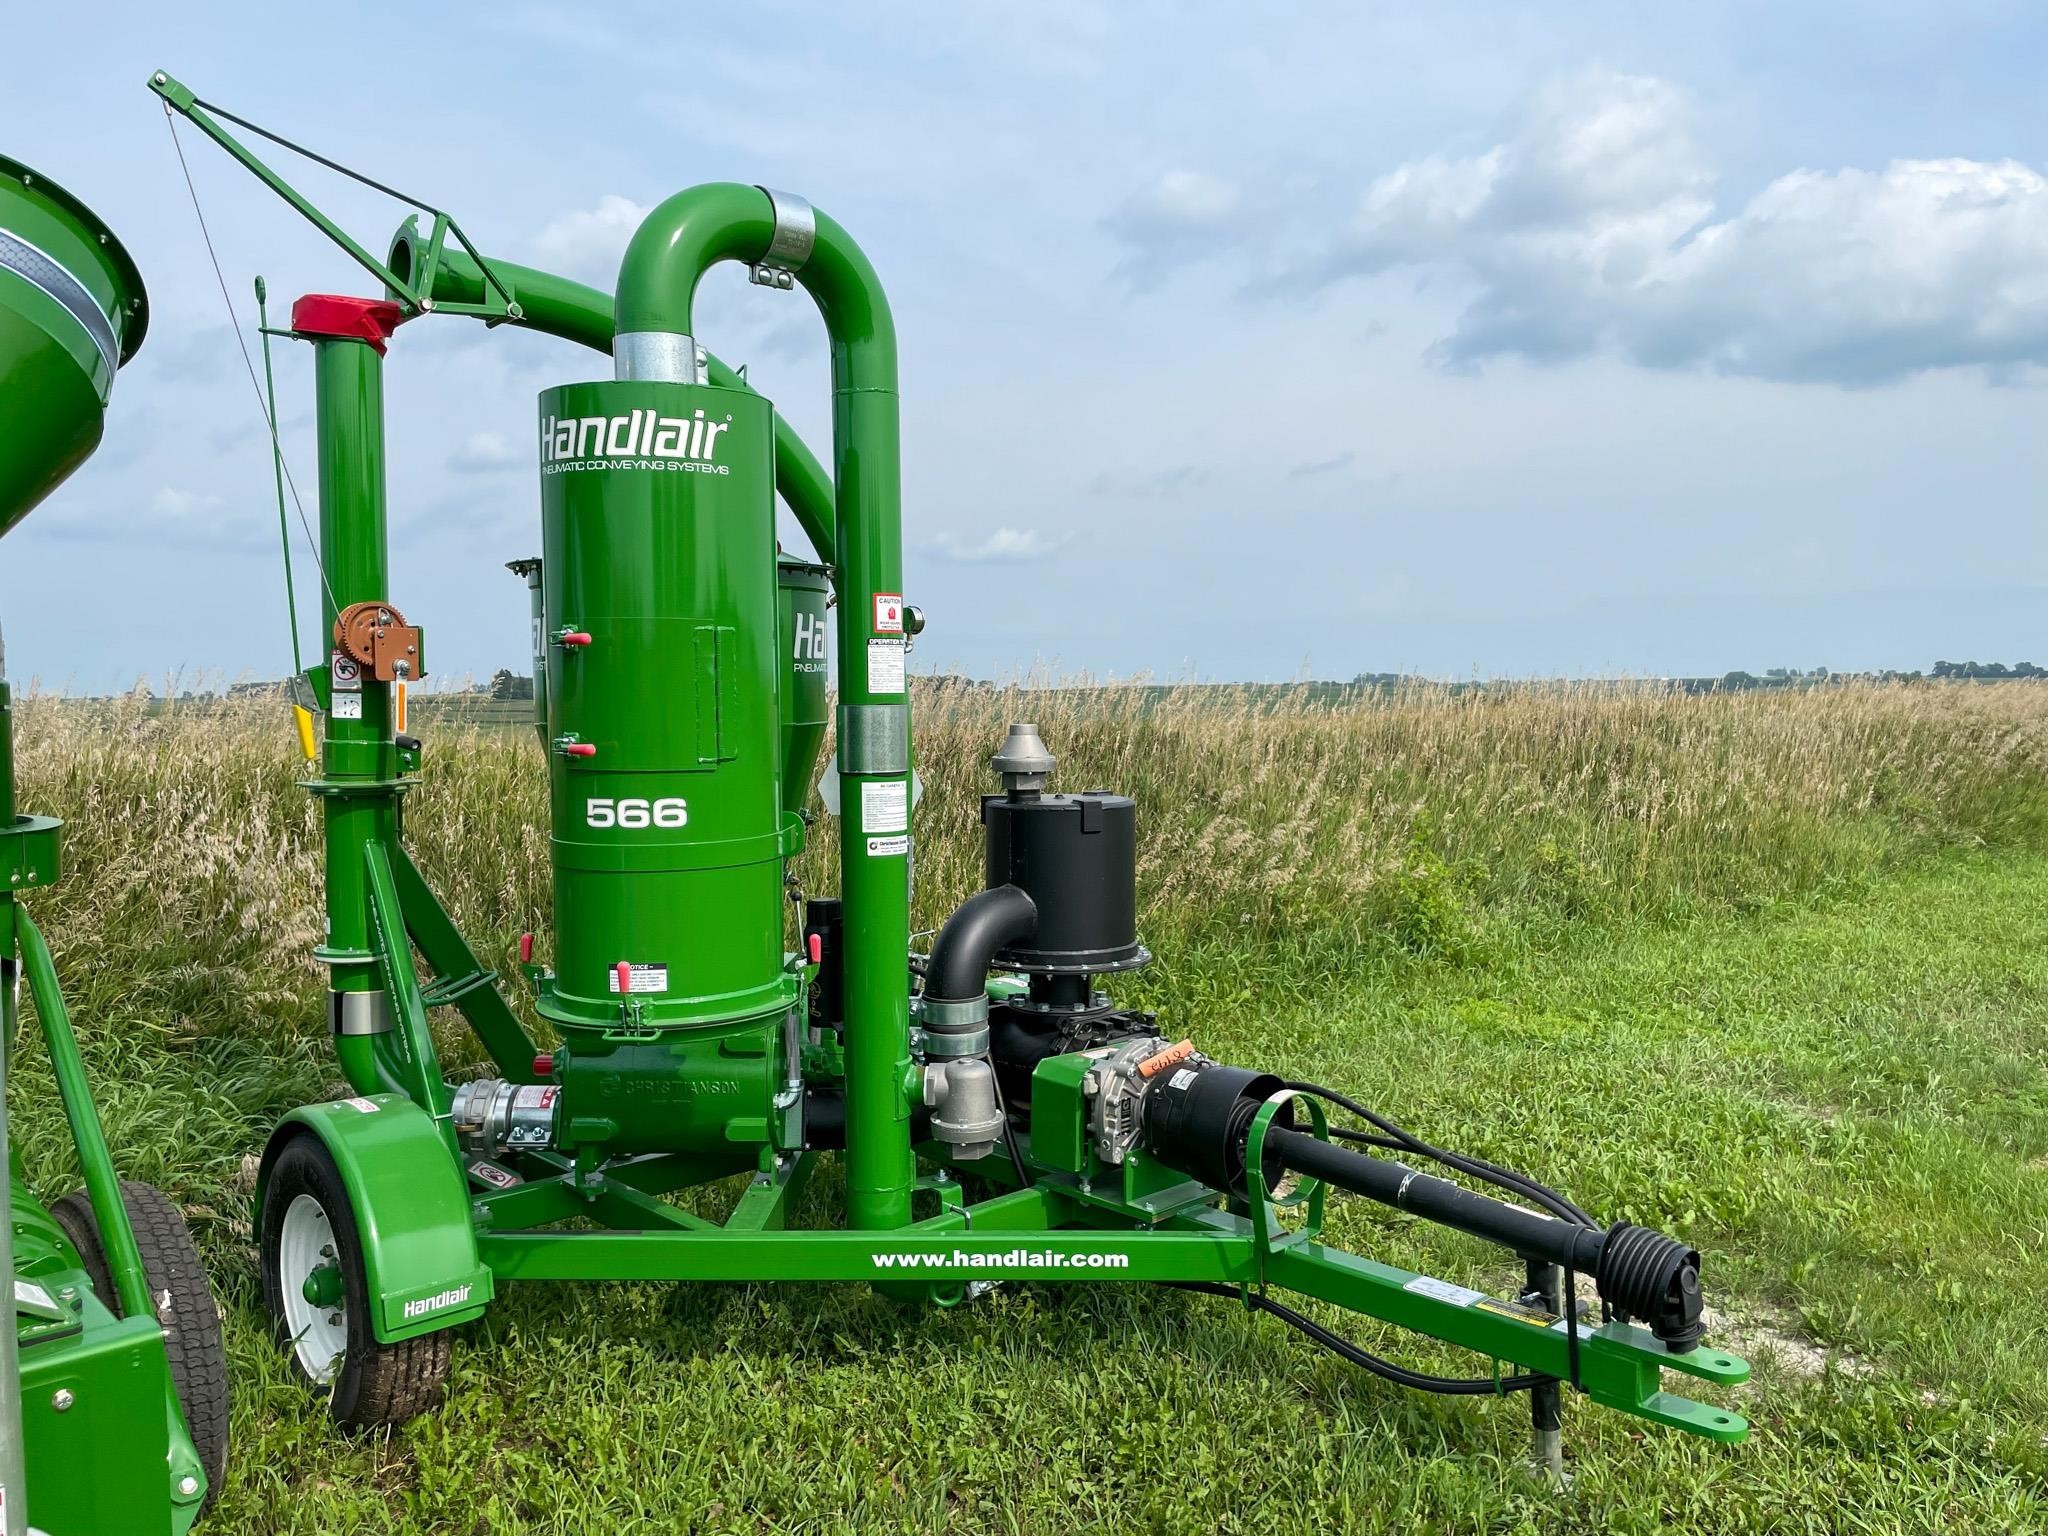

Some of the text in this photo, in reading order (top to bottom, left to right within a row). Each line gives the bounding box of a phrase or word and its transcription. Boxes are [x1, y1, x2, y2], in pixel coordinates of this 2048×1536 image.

[542, 409, 728, 462] Handlair
[543, 460, 729, 475] PNEUMATIC CONVEYING SYSTEMS
[794, 612, 827, 659] Ha
[587, 798, 688, 828] 566
[626, 1080, 740, 1095] CHRISTIANSON
[871, 1249, 1129, 1268] www.handlair.com
[404, 1284, 473, 1318] Handlair
